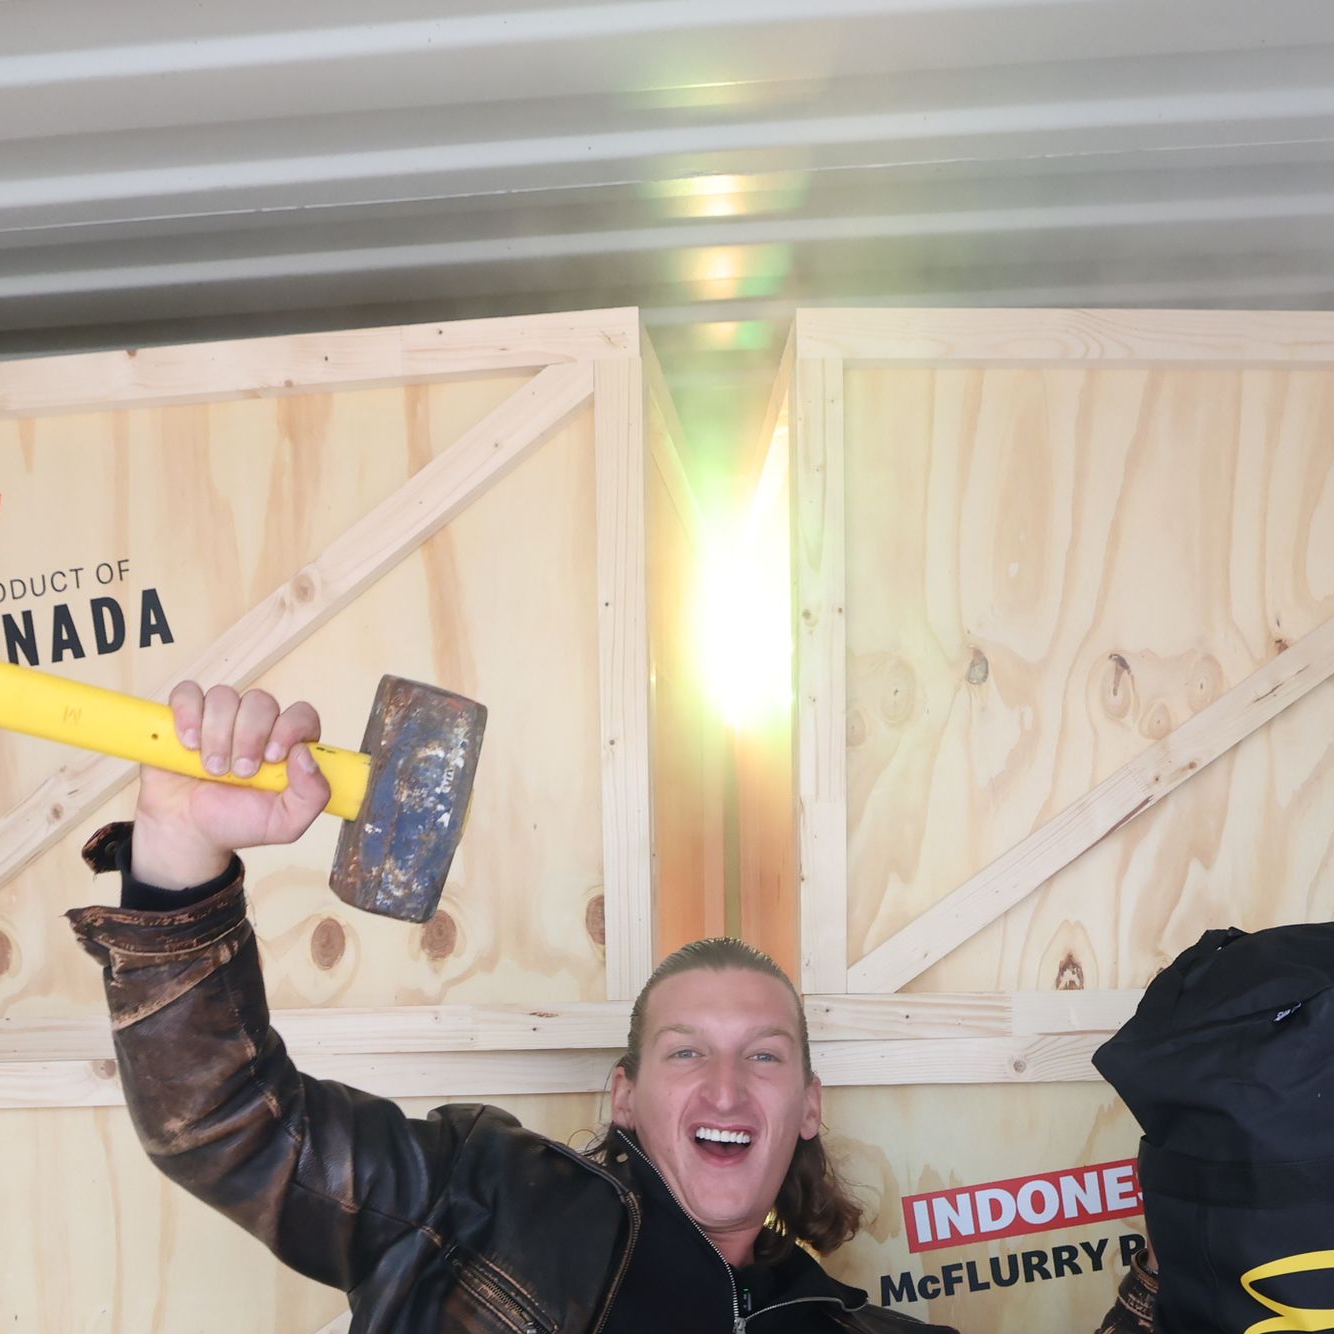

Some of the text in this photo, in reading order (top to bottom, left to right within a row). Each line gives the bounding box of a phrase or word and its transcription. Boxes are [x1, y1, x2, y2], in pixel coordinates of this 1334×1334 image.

[96, 559, 131, 586] OF
[913, 1164, 1144, 1244] INDONE
[880, 1238, 1108, 1307] McFLURRY
